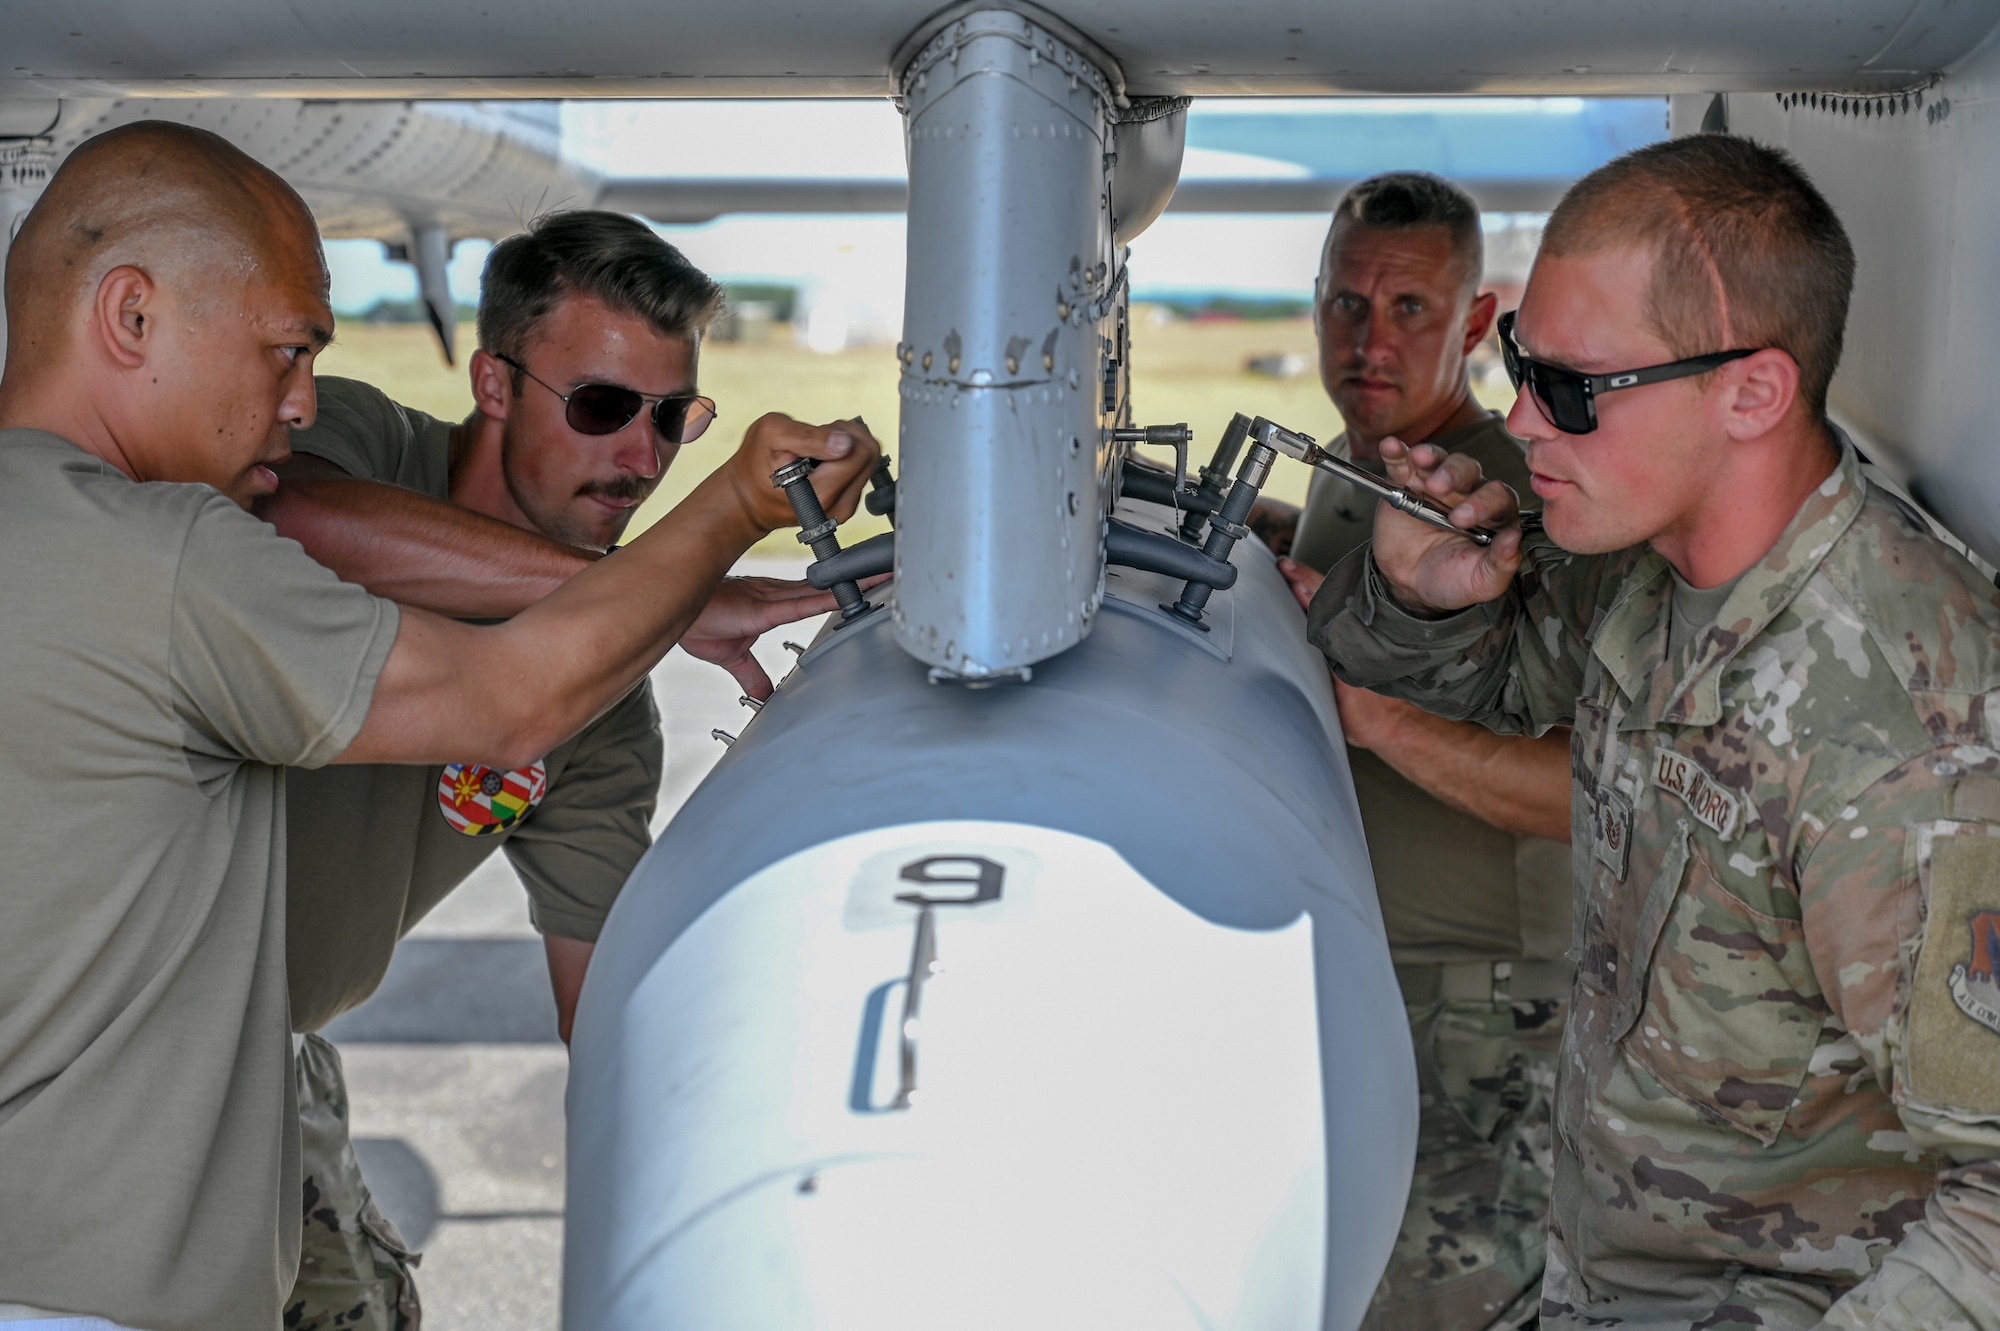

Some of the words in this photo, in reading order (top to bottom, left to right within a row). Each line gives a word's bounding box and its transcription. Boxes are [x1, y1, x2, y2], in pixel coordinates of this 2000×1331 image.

[1658, 753, 1687, 794] U.S.
[894, 853, 1006, 908] 9
[1977, 1006, 2000, 1029] COM
